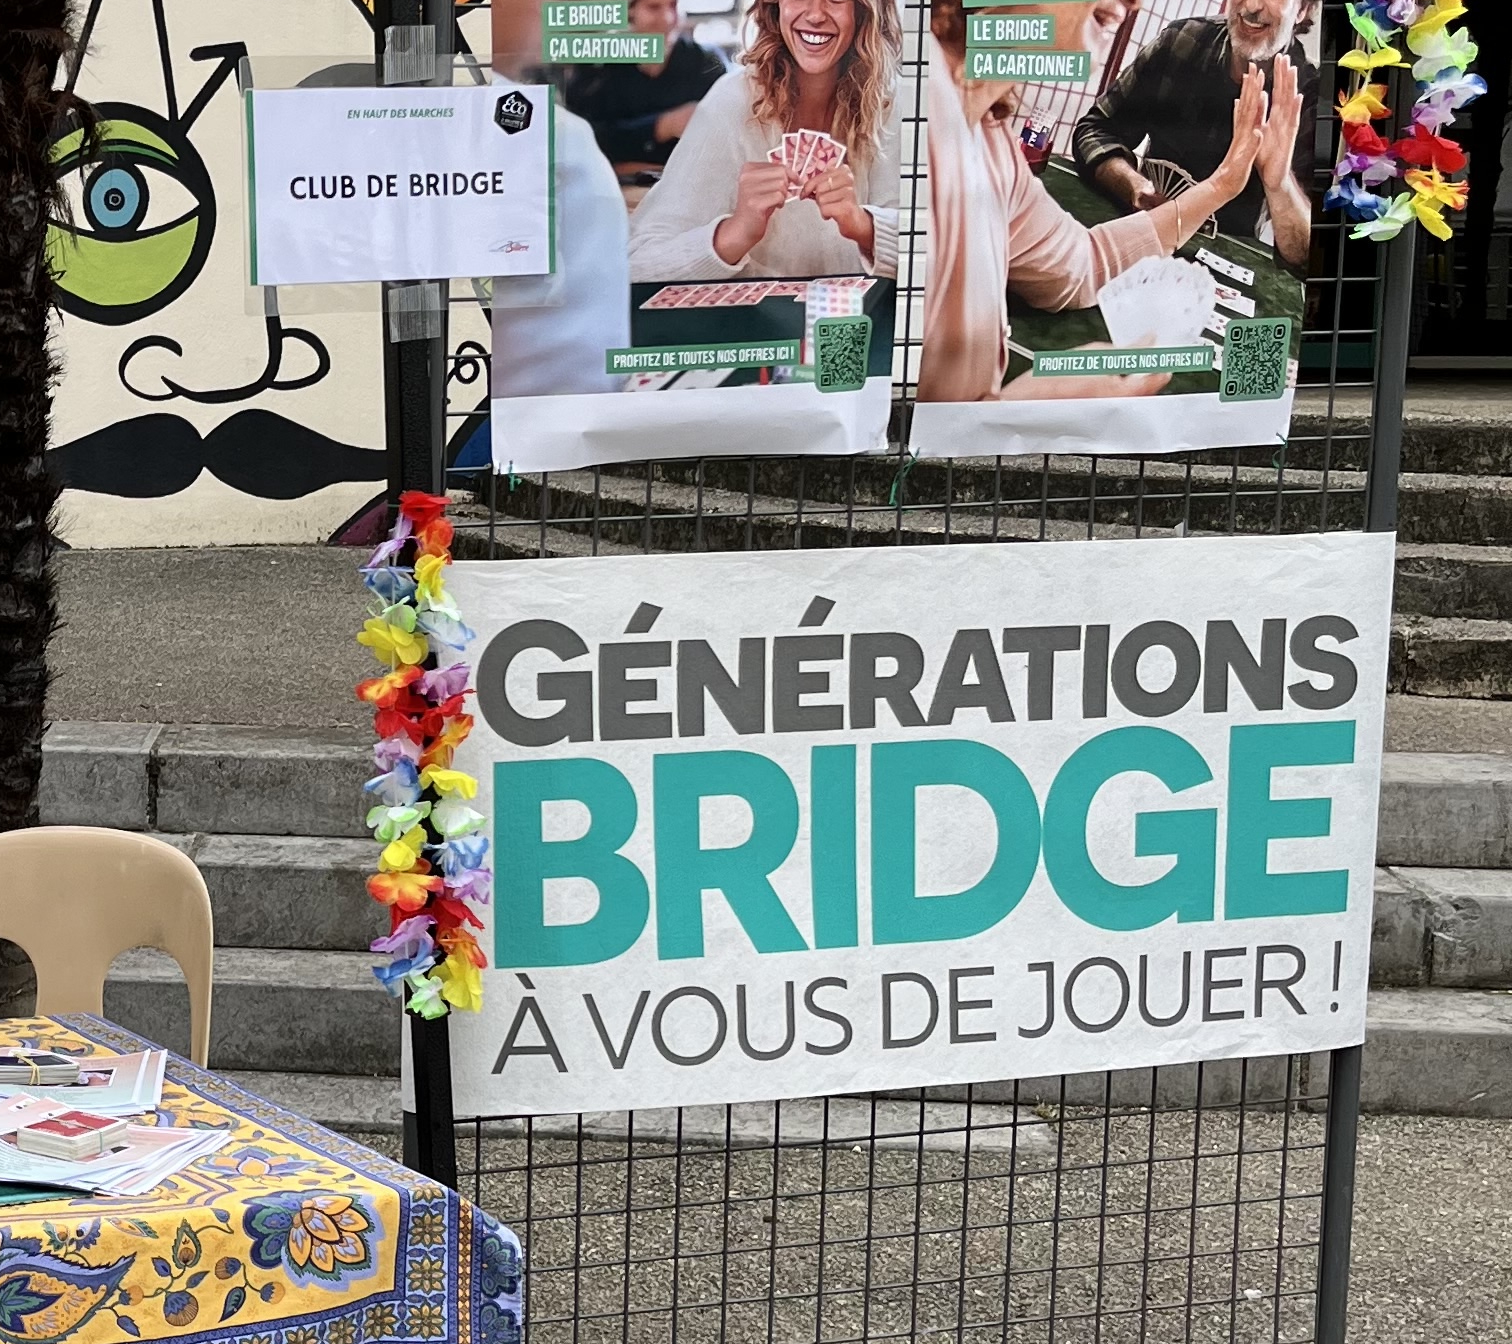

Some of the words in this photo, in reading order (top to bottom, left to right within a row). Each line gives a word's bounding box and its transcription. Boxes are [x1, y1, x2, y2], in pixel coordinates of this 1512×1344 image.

[548, 8, 566, 26] LE
[569, 5, 622, 25] BRIDGE
[973, 22, 992, 42] LE
[995, 19, 1048, 40] BRIDGE
[549, 38, 570, 61] ÇA
[572, 37, 649, 58] CARTONNE
[652, 37, 657, 57] !
[973, 55, 993, 79] ÇA
[997, 54, 1074, 76] CARTONNE
[1077, 56, 1083, 75] !
[347, 108, 361, 119] EN
[363, 108, 388, 119] HAUT
[390, 108, 408, 118] DES
[409, 107, 454, 118] MARCHES
[290, 175, 356, 199] CLUB
[367, 174, 398, 197] DE
[409, 171, 504, 197] BRIDGE
[613, 352, 661, 368] PROFITEZ
[663, 351, 676, 367] DE
[678, 350, 716, 366] TOUTES
[717, 349, 736, 364] NOS
[738, 348, 774, 363] OFFRES
[776, 347, 788, 361] ICI
[1039, 355, 1085, 371] PROFITEZ
[1086, 355, 1099, 370] DE
[1102, 354, 1137, 369] TOUTES
[1138, 354, 1158, 368] NOS
[1159, 353, 1191, 367] OFFRES
[1192, 352, 1204, 366] ICI
[476, 594, 1359, 748] GÉNÉRATIONS
[492, 720, 1357, 969] BRIDGE
[491, 972, 570, 1075] À
[583, 975, 853, 1071] VOUS
[881, 965, 999, 1050] DE
[1017, 944, 1310, 1039] JOUER
[1328, 940, 1343, 1014] !
